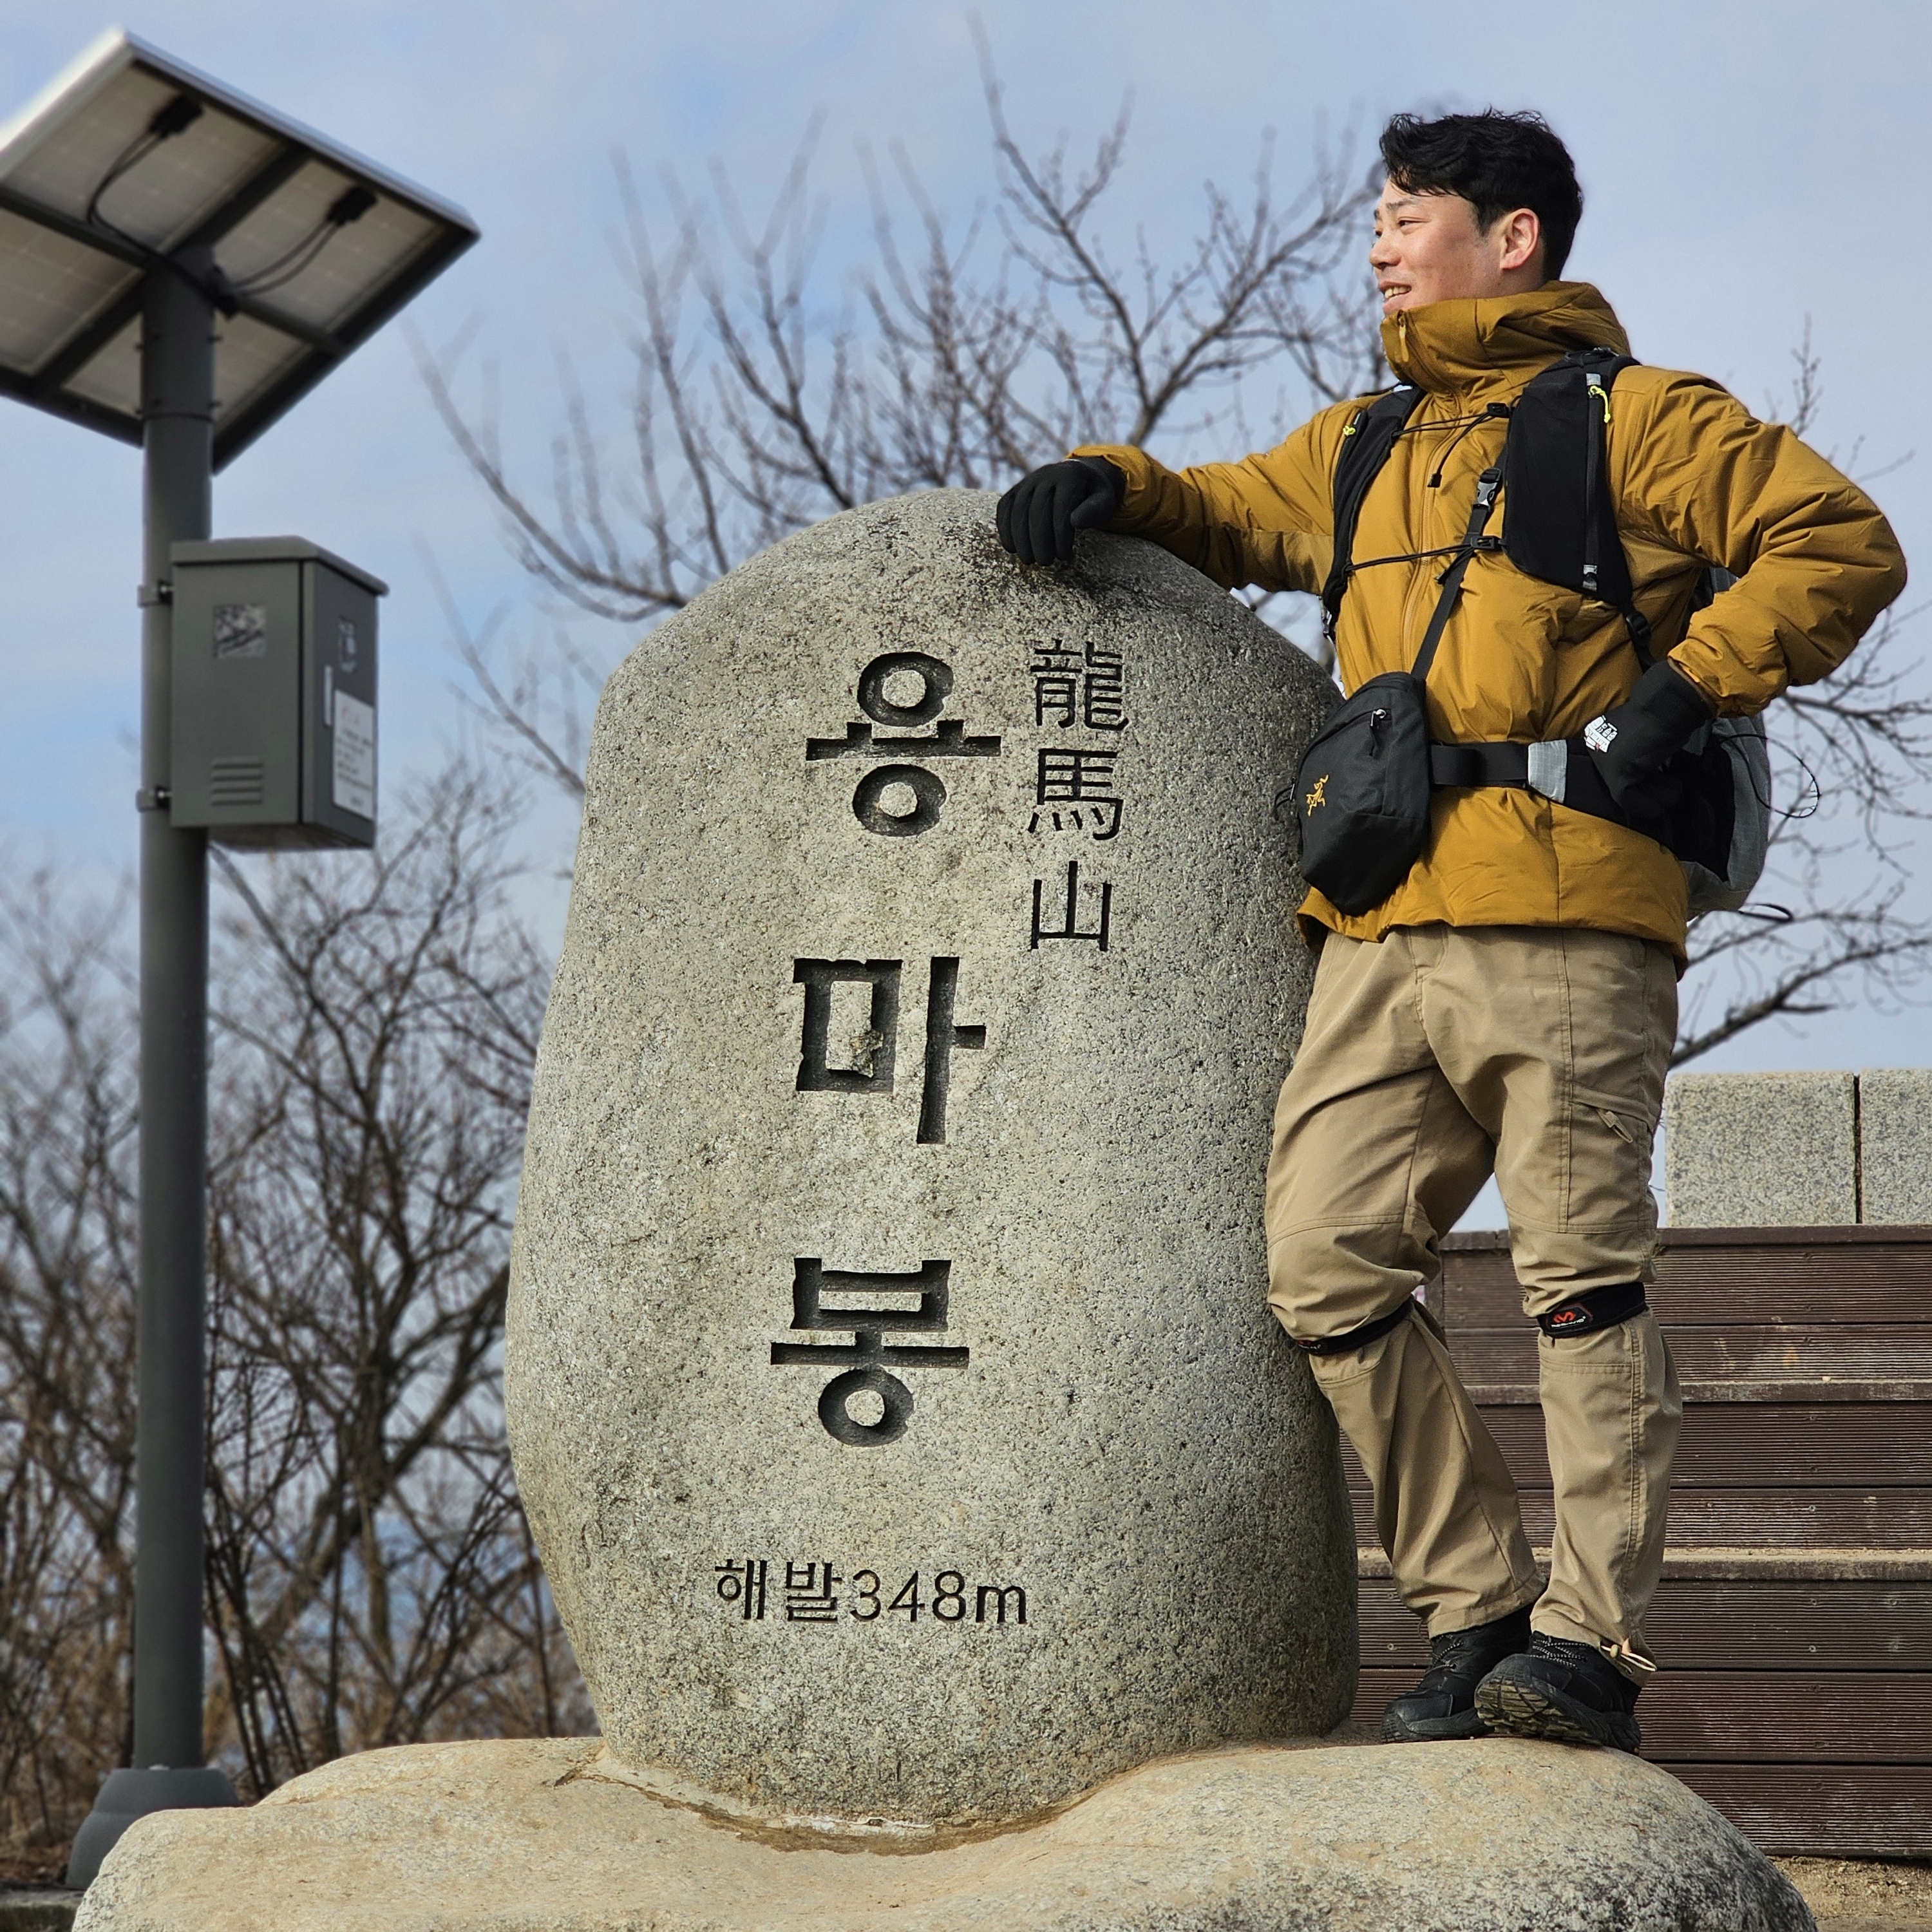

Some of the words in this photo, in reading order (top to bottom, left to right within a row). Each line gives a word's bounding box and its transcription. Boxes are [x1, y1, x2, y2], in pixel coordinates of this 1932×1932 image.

[769, 650, 1002, 1448] 용마봉
[1028, 639, 1130, 952] 龍馬山
